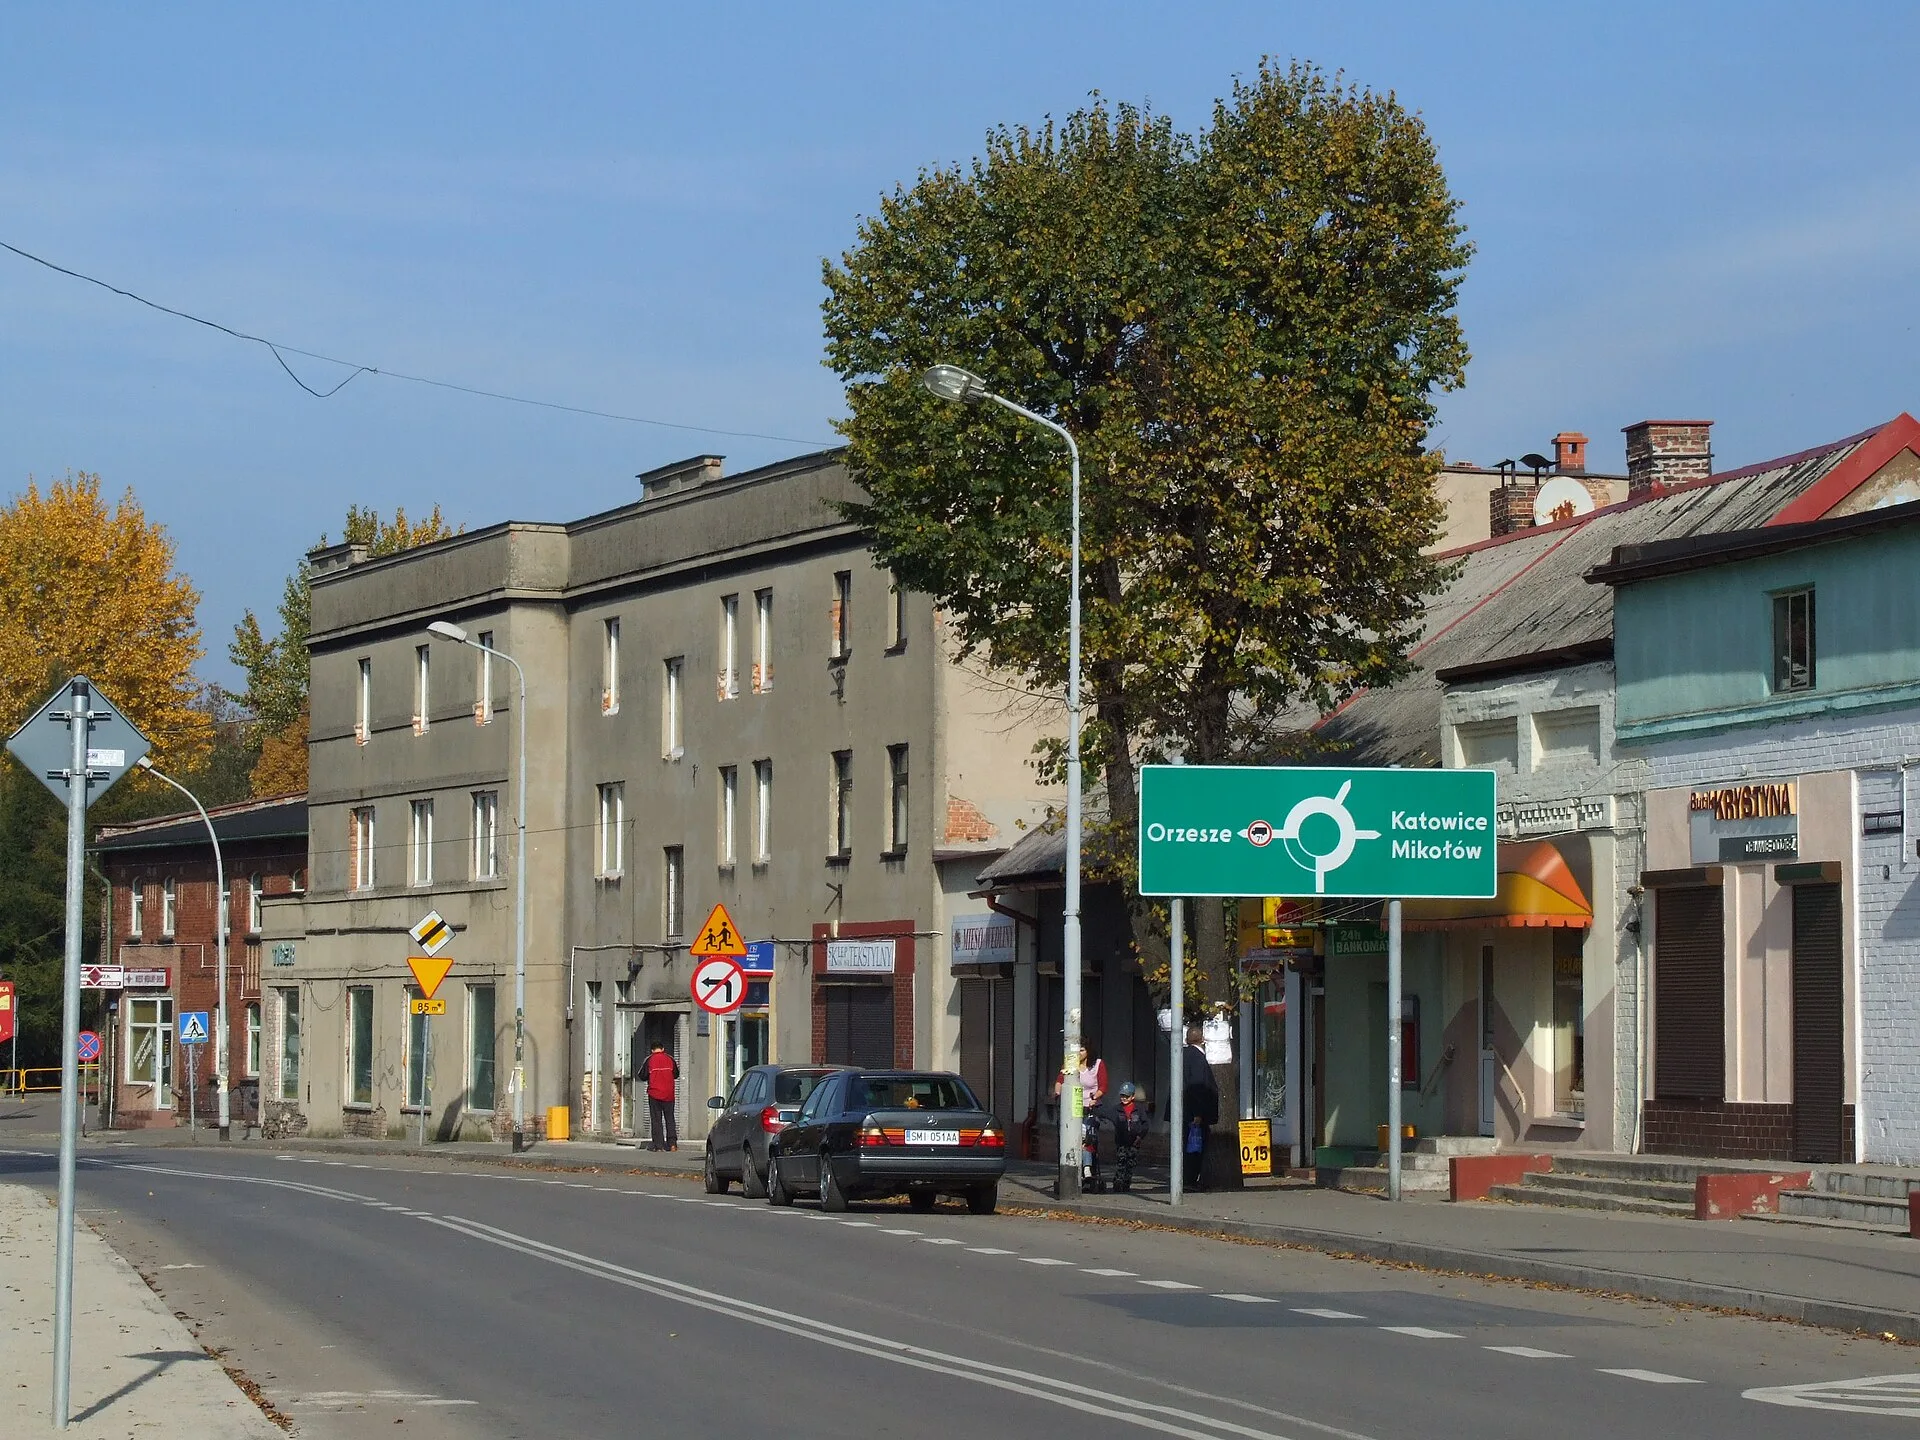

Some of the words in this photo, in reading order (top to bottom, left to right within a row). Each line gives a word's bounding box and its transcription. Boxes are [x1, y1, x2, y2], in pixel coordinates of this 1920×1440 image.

[1714, 783, 1791, 820] KRYSTYNA
[1391, 811, 1488, 831] Katowice
[1147, 822, 1232, 843] Orzesze
[1391, 839, 1482, 859] Mikołów
[1340, 929, 1361, 941] 24h
[848, 946, 892, 967] TEKSTYLNY
[417, 1002, 429, 1011] 85
[911, 1131, 927, 1142] SMI
[930, 1132, 958, 1142] 051AA
[1241, 1146, 1268, 1164] 0,15
